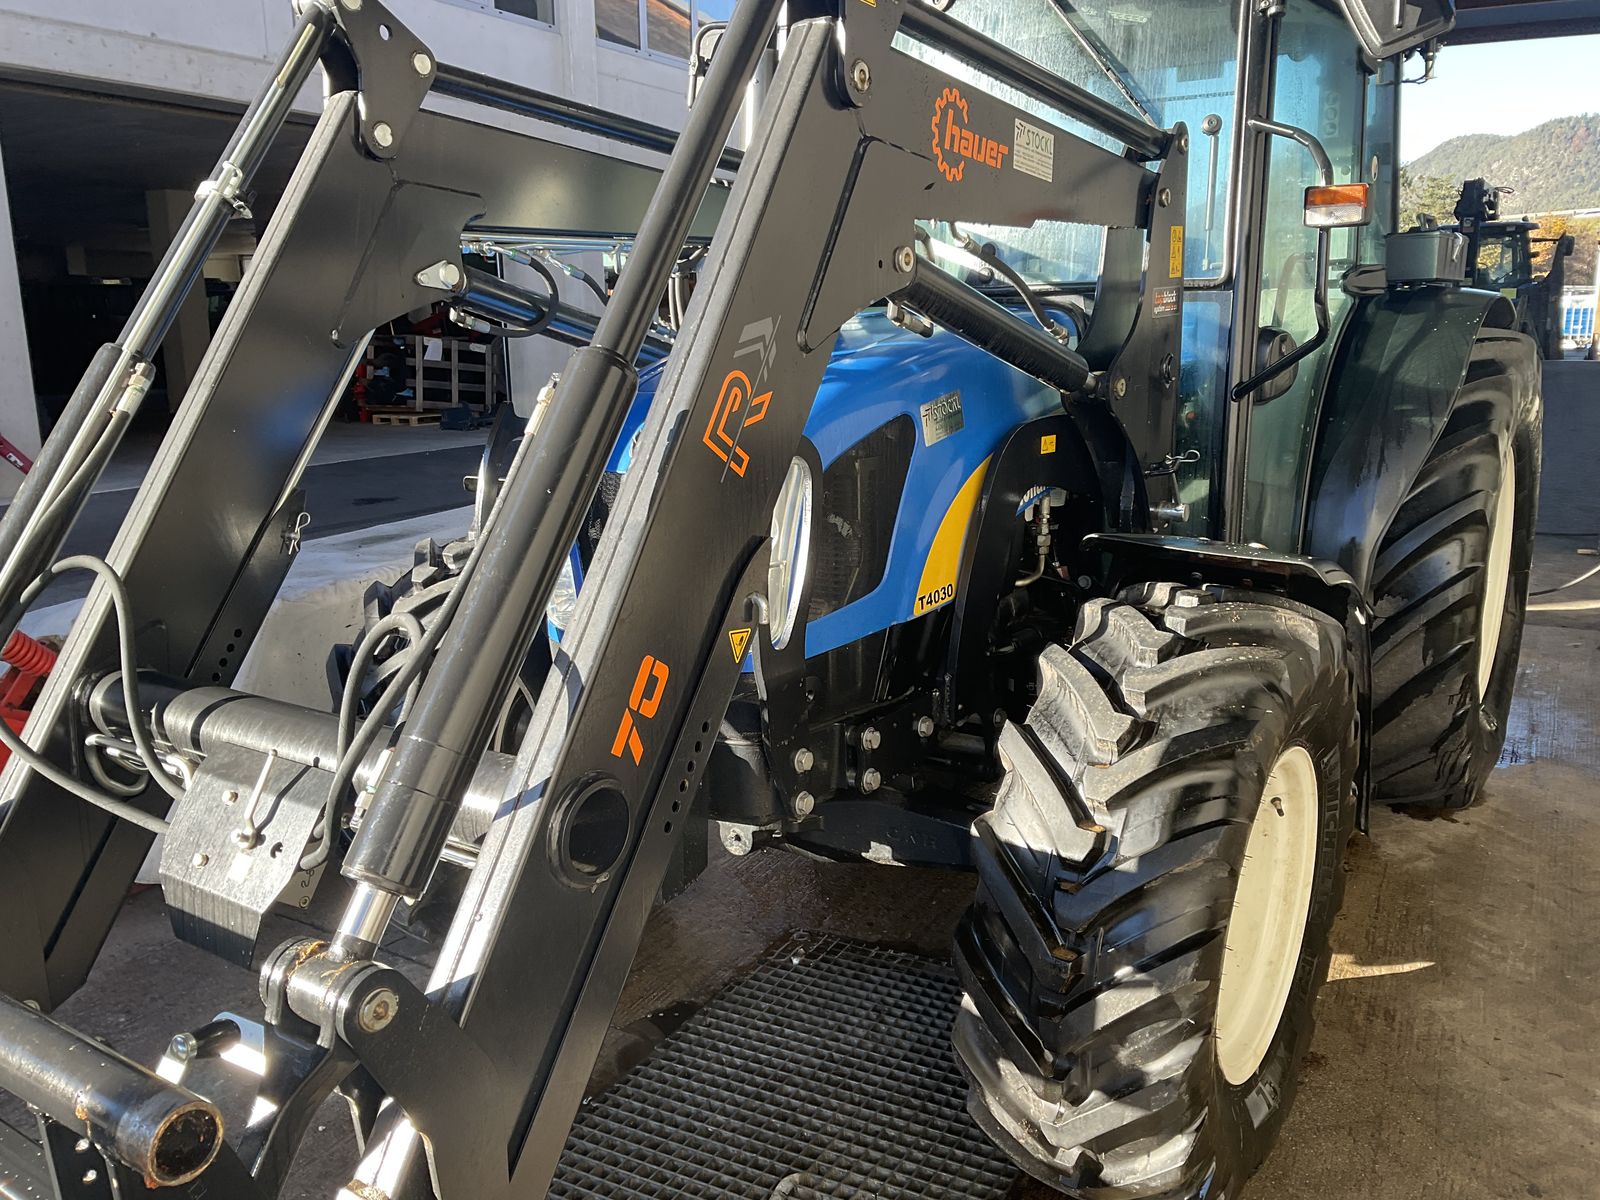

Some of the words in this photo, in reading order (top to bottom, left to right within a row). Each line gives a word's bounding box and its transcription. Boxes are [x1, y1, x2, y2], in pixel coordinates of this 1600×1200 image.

[944, 108, 1009, 169] hauer
[918, 583, 954, 610] T4030
[610, 654, 670, 767] 70
